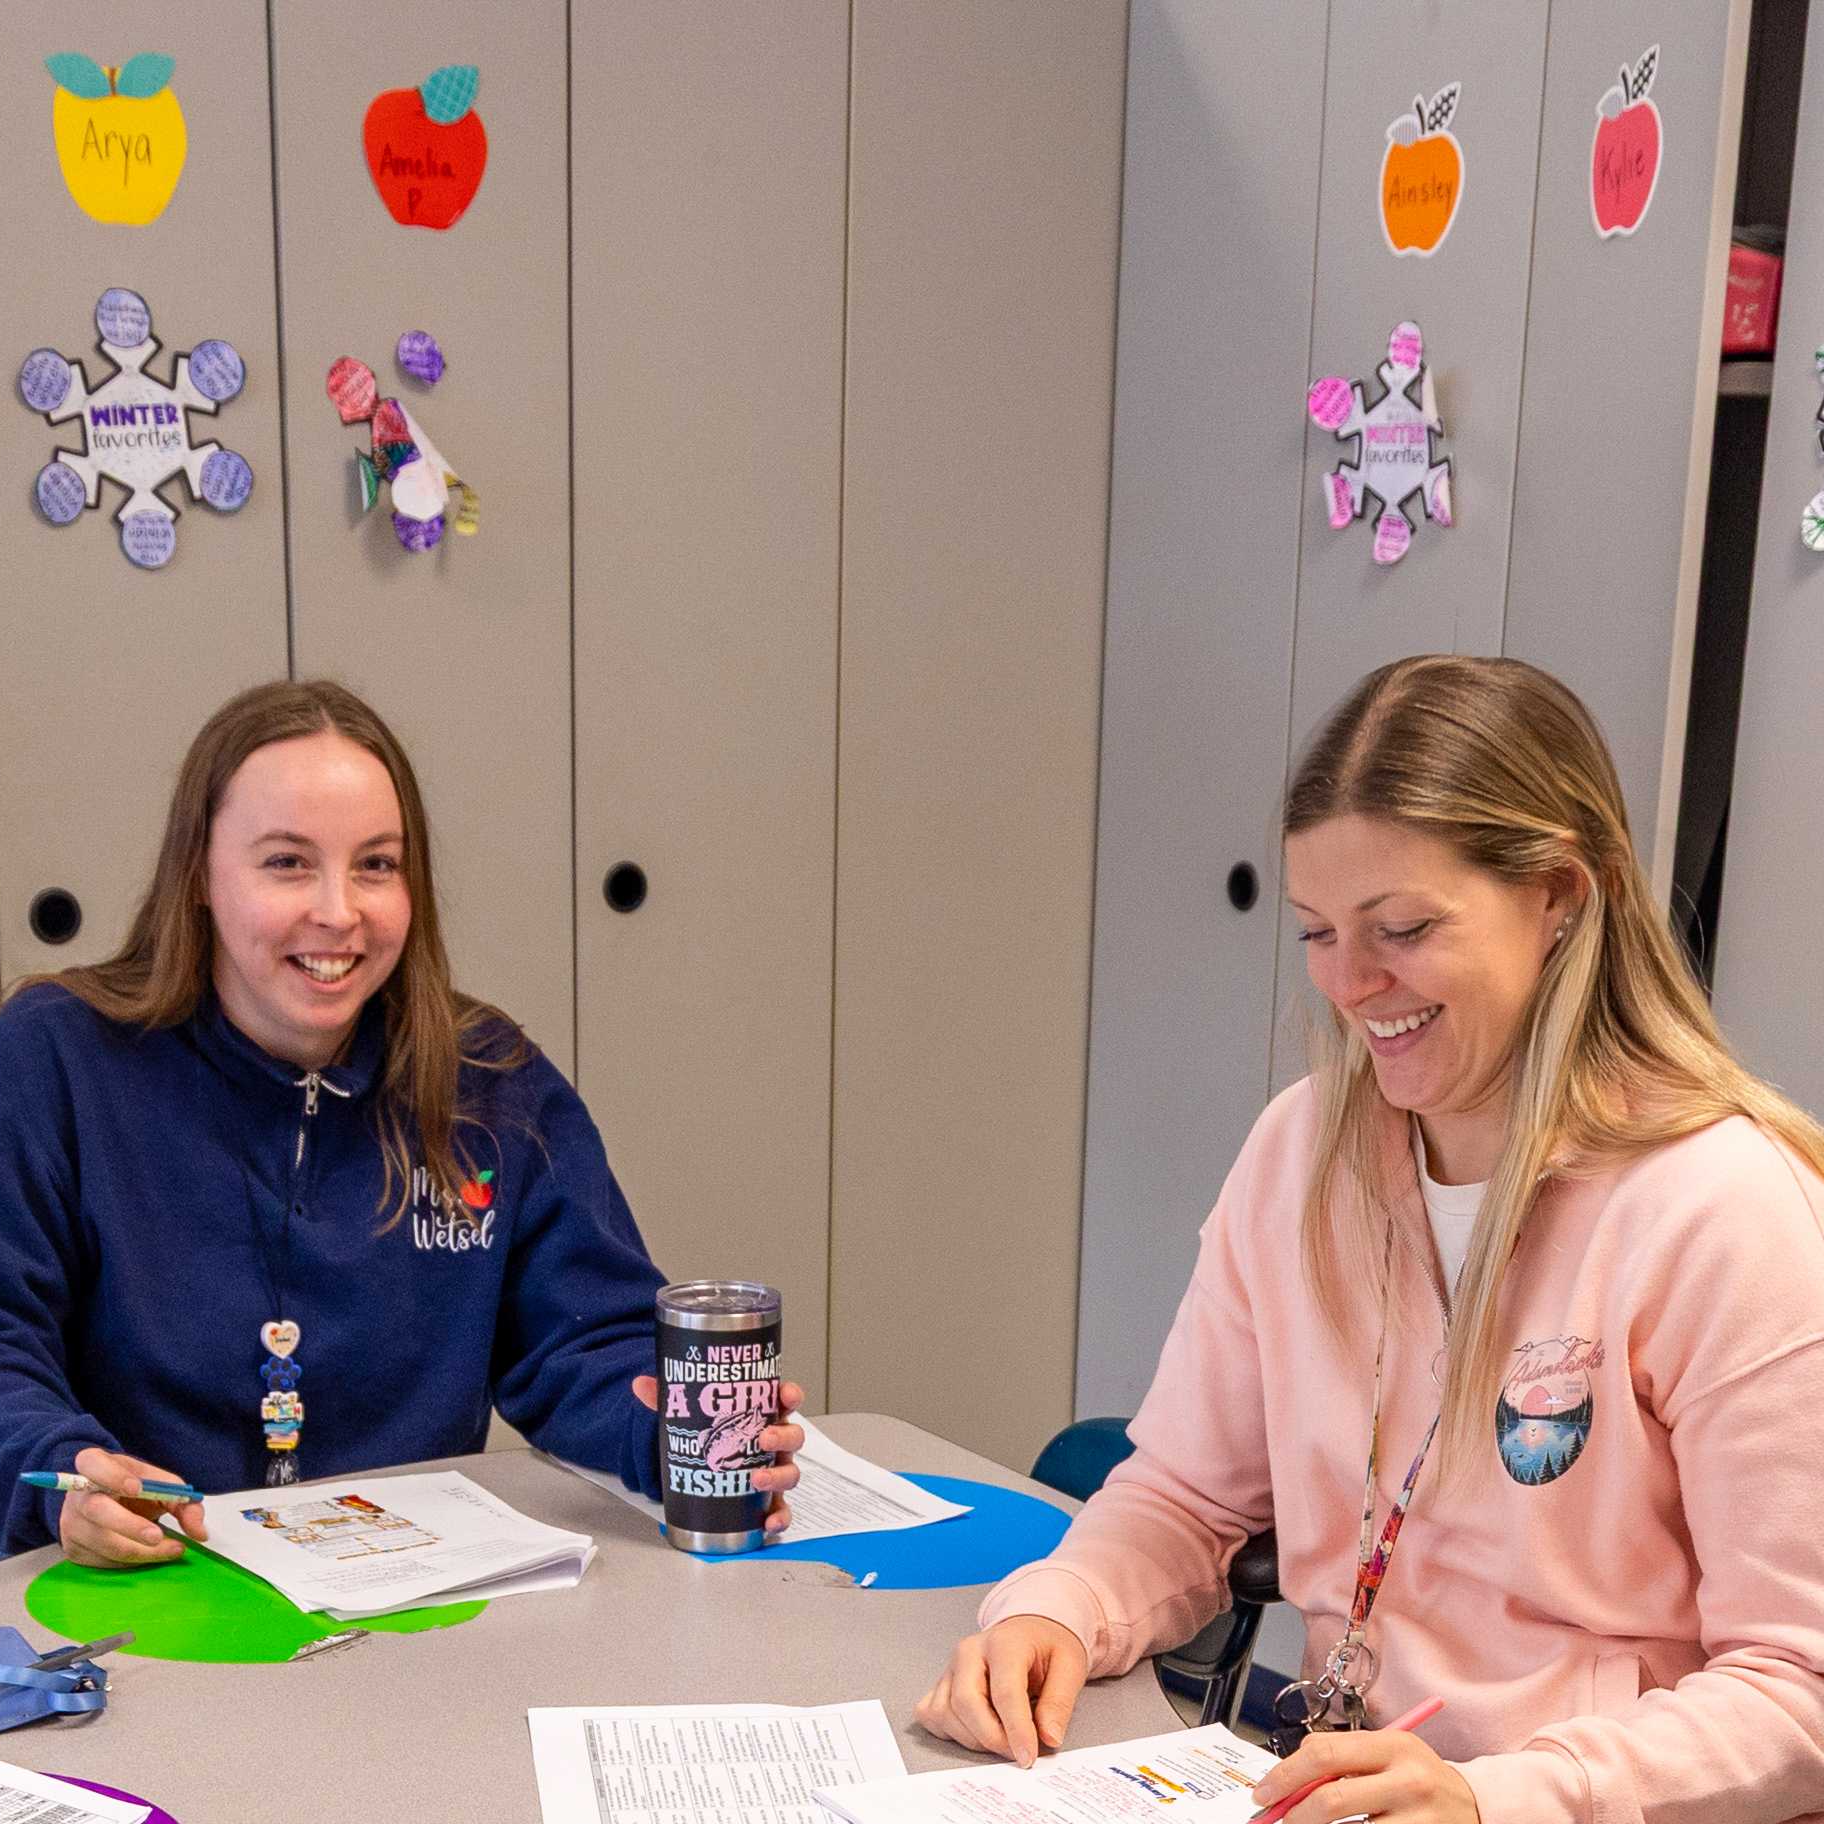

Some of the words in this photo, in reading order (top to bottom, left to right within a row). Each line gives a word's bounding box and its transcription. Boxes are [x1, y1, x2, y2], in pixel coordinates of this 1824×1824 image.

[81, 116, 152, 187] Arya
[380, 143, 456, 179] Amelia
[1388, 175, 1453, 213] Ainsley
[89, 403, 180, 427] WINTER
[92, 429, 182, 450] favorites
[1365, 423, 1426, 445] WINTER
[1364, 449, 1426, 465] favorites
[413, 1209, 496, 1253] Wetsel
[707, 1343, 762, 1363] NEVER
[664, 1355, 782, 1382] UNDERESTIMAT
[665, 1383, 691, 1418] A
[668, 1435, 700, 1456] WHO
